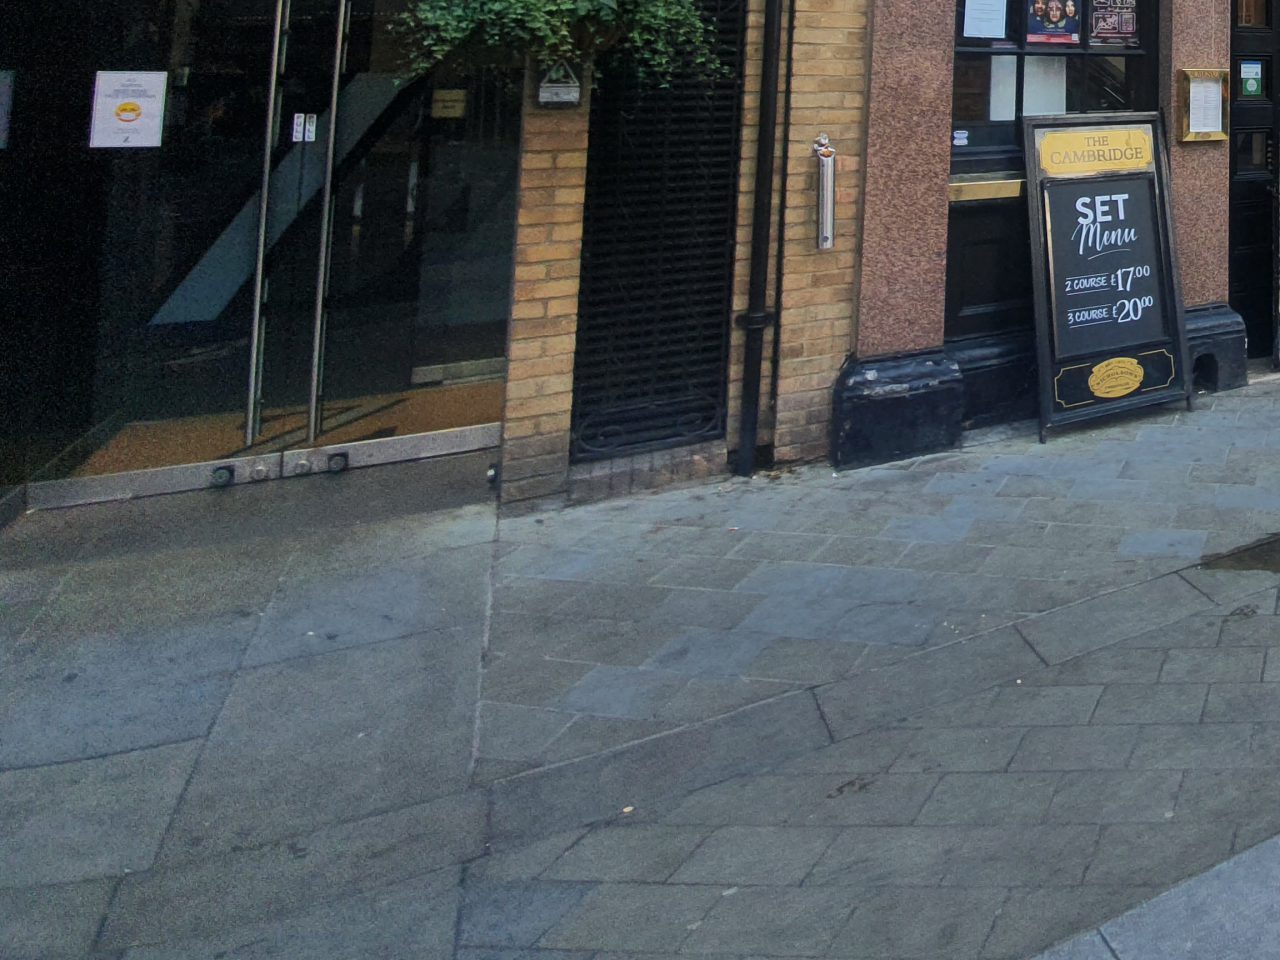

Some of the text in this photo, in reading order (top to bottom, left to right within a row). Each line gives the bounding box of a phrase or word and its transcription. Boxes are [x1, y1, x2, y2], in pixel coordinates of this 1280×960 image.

[1084, 136, 1109, 147] THE
[1050, 147, 1144, 165] CAMBRIDGE
[1075, 193, 1129, 225] SET
[1071, 222, 1138, 255] Menu
[1065, 281, 1071, 292] 2
[1074, 276, 1108, 290] COURSE
[1067, 313, 1074, 324] 3
[1075, 307, 1109, 322] COURSE
